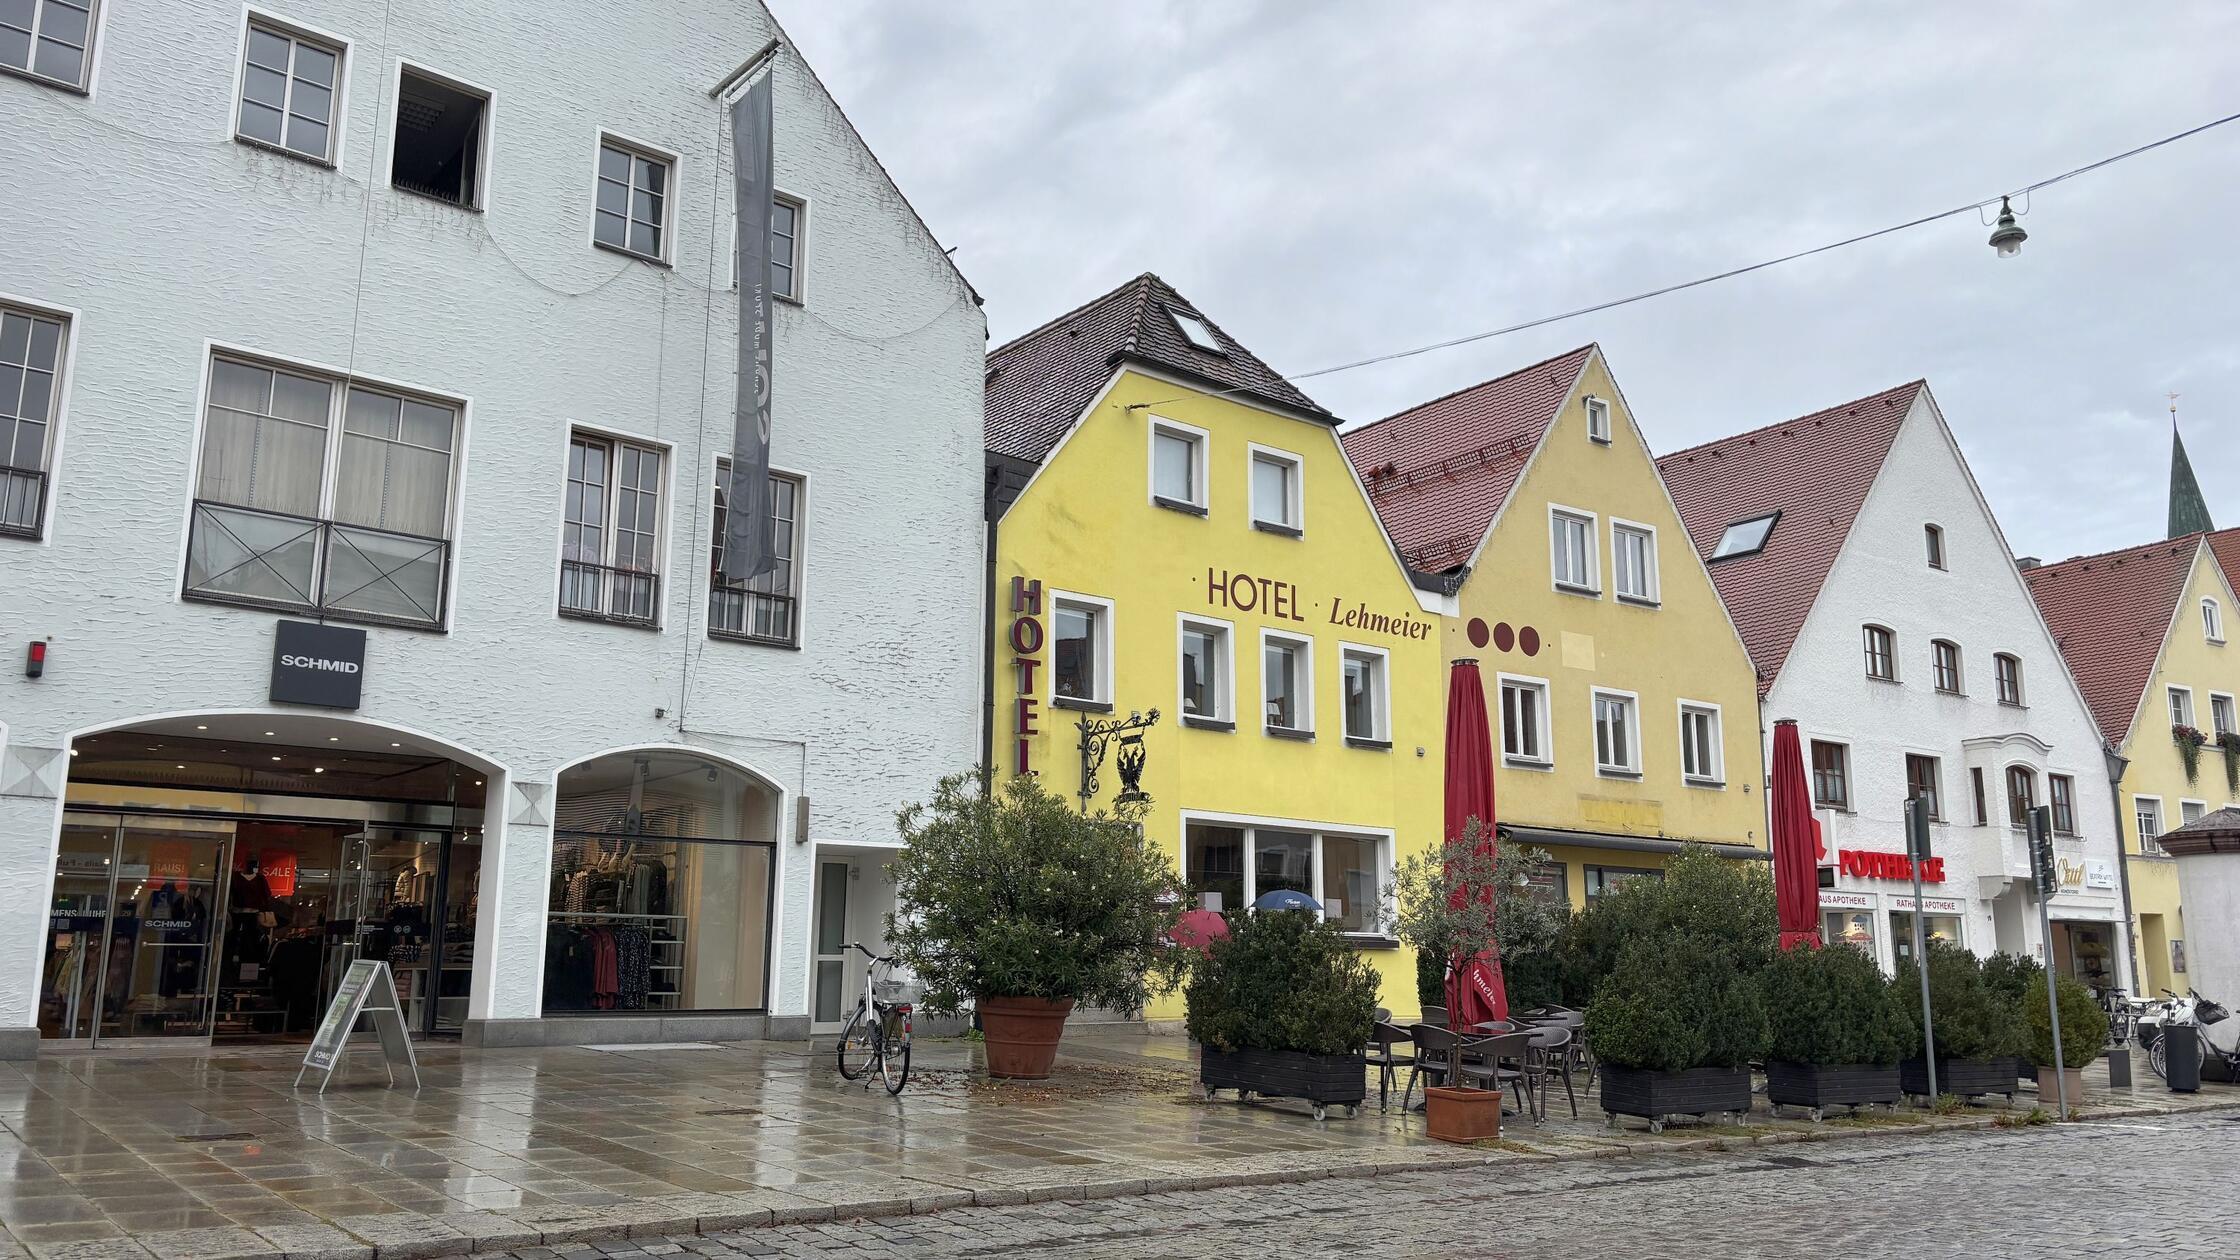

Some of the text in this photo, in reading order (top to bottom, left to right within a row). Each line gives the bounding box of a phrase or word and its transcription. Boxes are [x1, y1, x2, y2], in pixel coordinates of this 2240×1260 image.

[1208, 567, 1431, 640] HOTEL Lehmeier
[281, 654, 359, 674] SCHMID
[1009, 576, 1044, 776] HOTEL
[262, 867, 291, 878] SALE
[1832, 895, 1866, 905] APOTHEKE
[1896, 899, 1955, 910] RATHAS APOTHEKE
[144, 919, 192, 928] SCHMID
